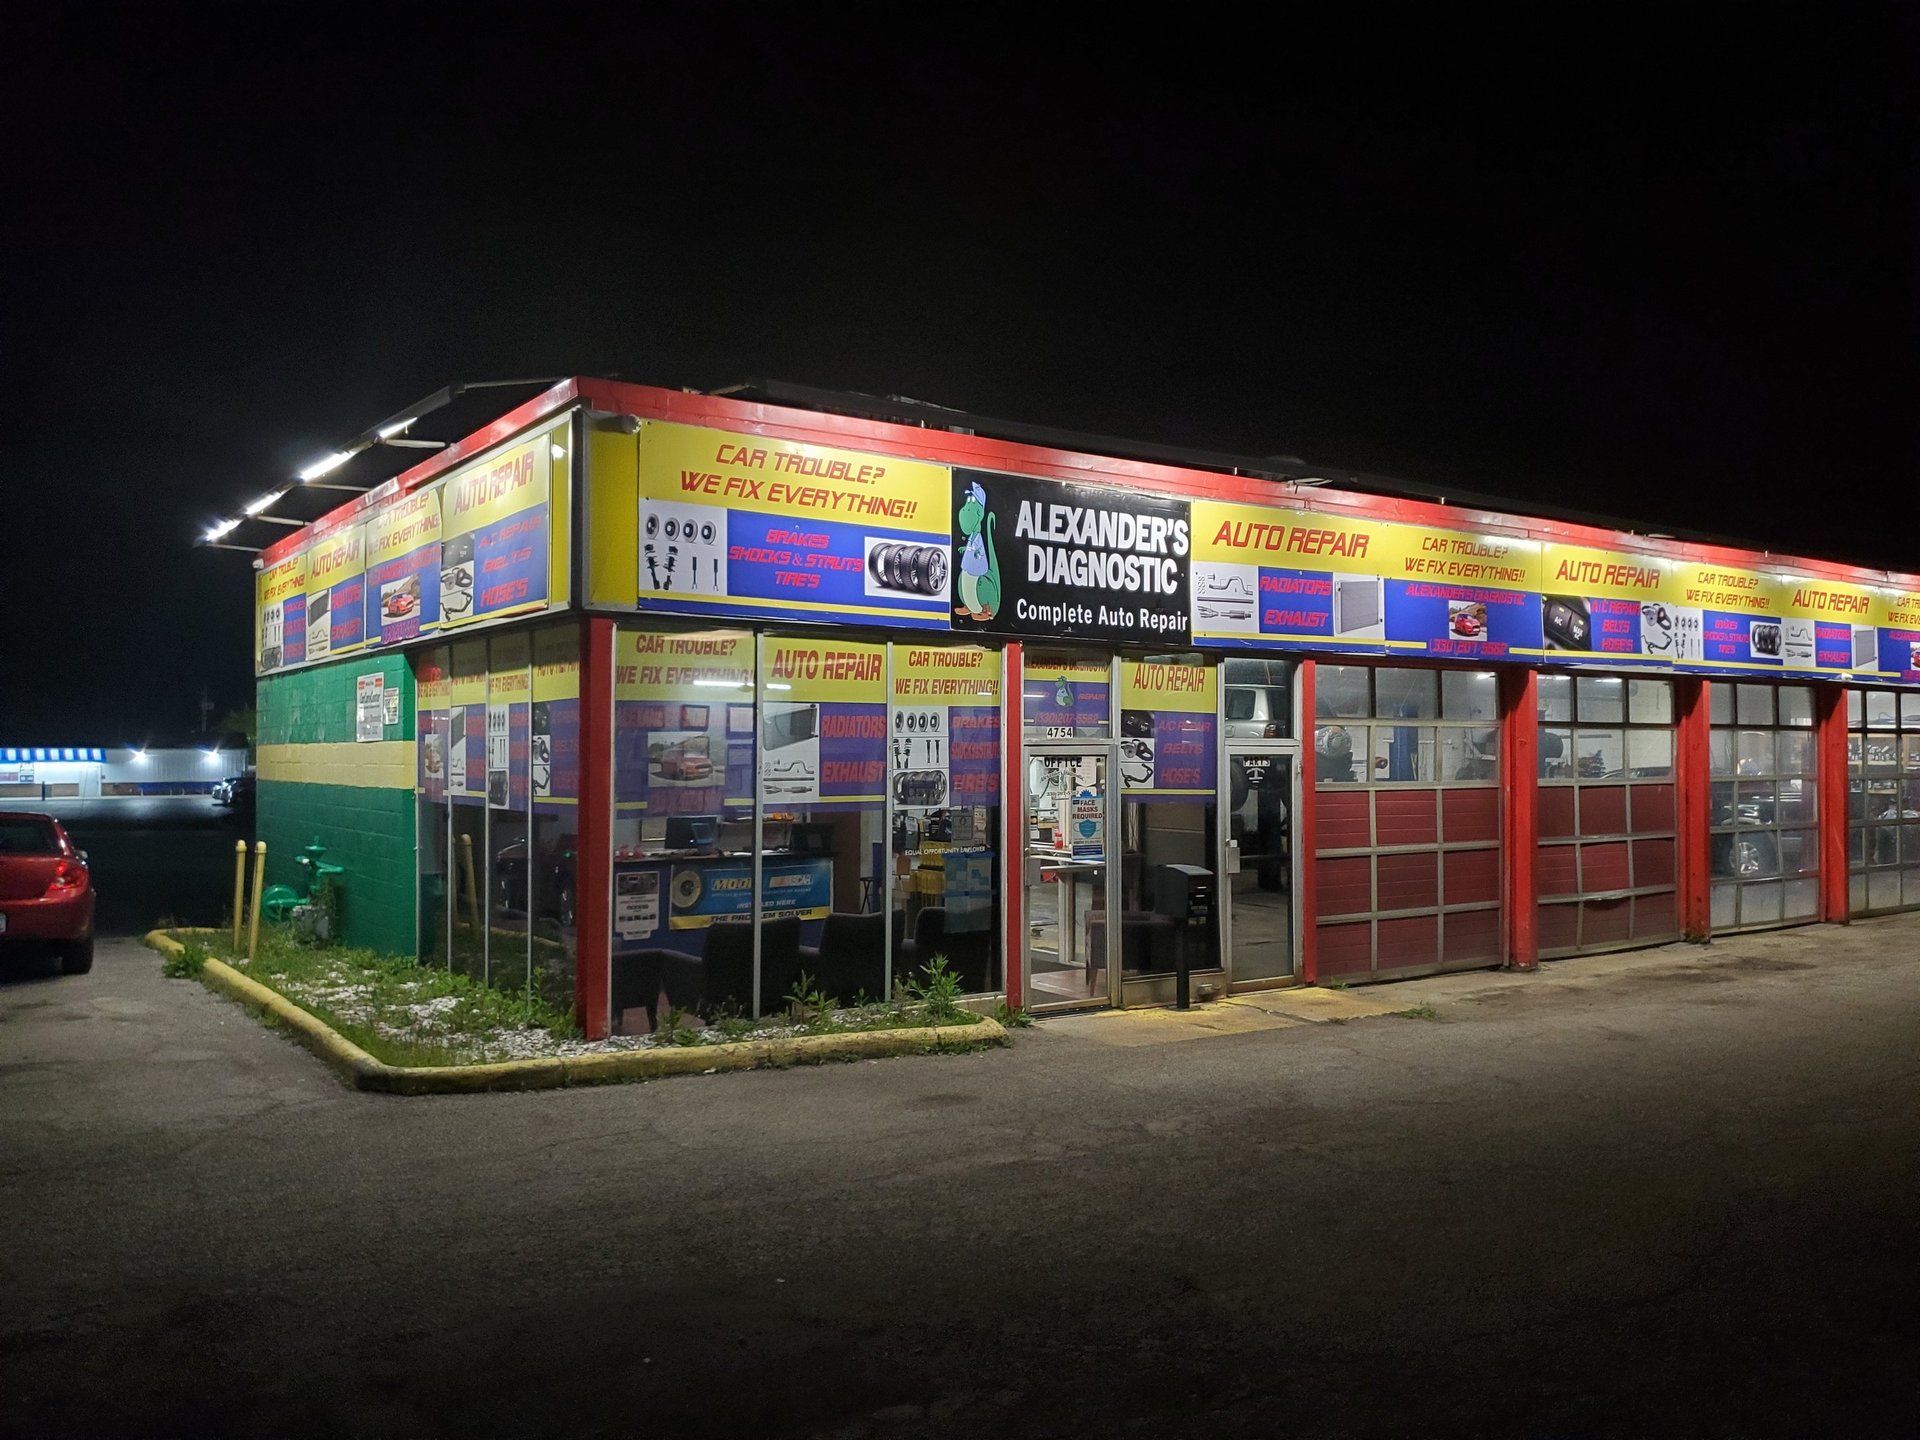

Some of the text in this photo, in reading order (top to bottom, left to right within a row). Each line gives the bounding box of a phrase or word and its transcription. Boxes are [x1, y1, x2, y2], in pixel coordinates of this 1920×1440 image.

[715, 444, 886, 485] CAR TROUBLE?
[454, 450, 535, 516] AUTO REPAIR
[681, 470, 918, 519] WE FIX EVERYTHING!!
[766, 529, 830, 549] BRAKES
[1015, 500, 1189, 556] ALEXANDER'S
[1212, 520, 1370, 559] AUTO REPAIR
[729, 546, 865, 572] SHOCKS & STRUTS
[1422, 537, 1508, 560] CAR TROUBLE?
[311, 556, 332, 579] AUTO
[1028, 545, 1178, 594] DIAGNOSTIC
[1405, 557, 1527, 583] WE FIX EVERYTHING!!
[1556, 559, 1660, 590] AUTO REPAIR
[1259, 575, 1332, 596] RADIATORS
[1698, 572, 1759, 589] CAR TROUBLE?
[1686, 589, 1770, 609] WE FIX EVERYTHING!!
[1792, 589, 1870, 614] AUTO REPAIR
[1897, 597, 1911, 607] CAR
[1017, 598, 1188, 633] Complete Auto Repair
[1264, 609, 1329, 627] EXHAUST
[1888, 611, 1899, 622] WE
[1899, 613, 1909, 623] FIX
[636, 634, 736, 657] CAR TROUBLE?
[771, 649, 882, 682] AUTO REPAIR
[908, 650, 984, 668] CAR TROUBLE?
[616, 665, 638, 685] WE
[640, 666, 662, 685] FIX
[895, 678, 999, 695] WE FIX EVERYTHING!!
[1133, 664, 1206, 692] AUTO REPAIR
[821, 715, 886, 739] RADIATORS
[952, 715, 999, 729] BRAKES
[1047, 727, 1073, 738] 4754
[1163, 743, 1205, 755] BELTS
[821, 760, 887, 784] EXHAUST
[1044, 757, 1082, 768] OFFICE
[778, 909, 812, 918] SOLVER
